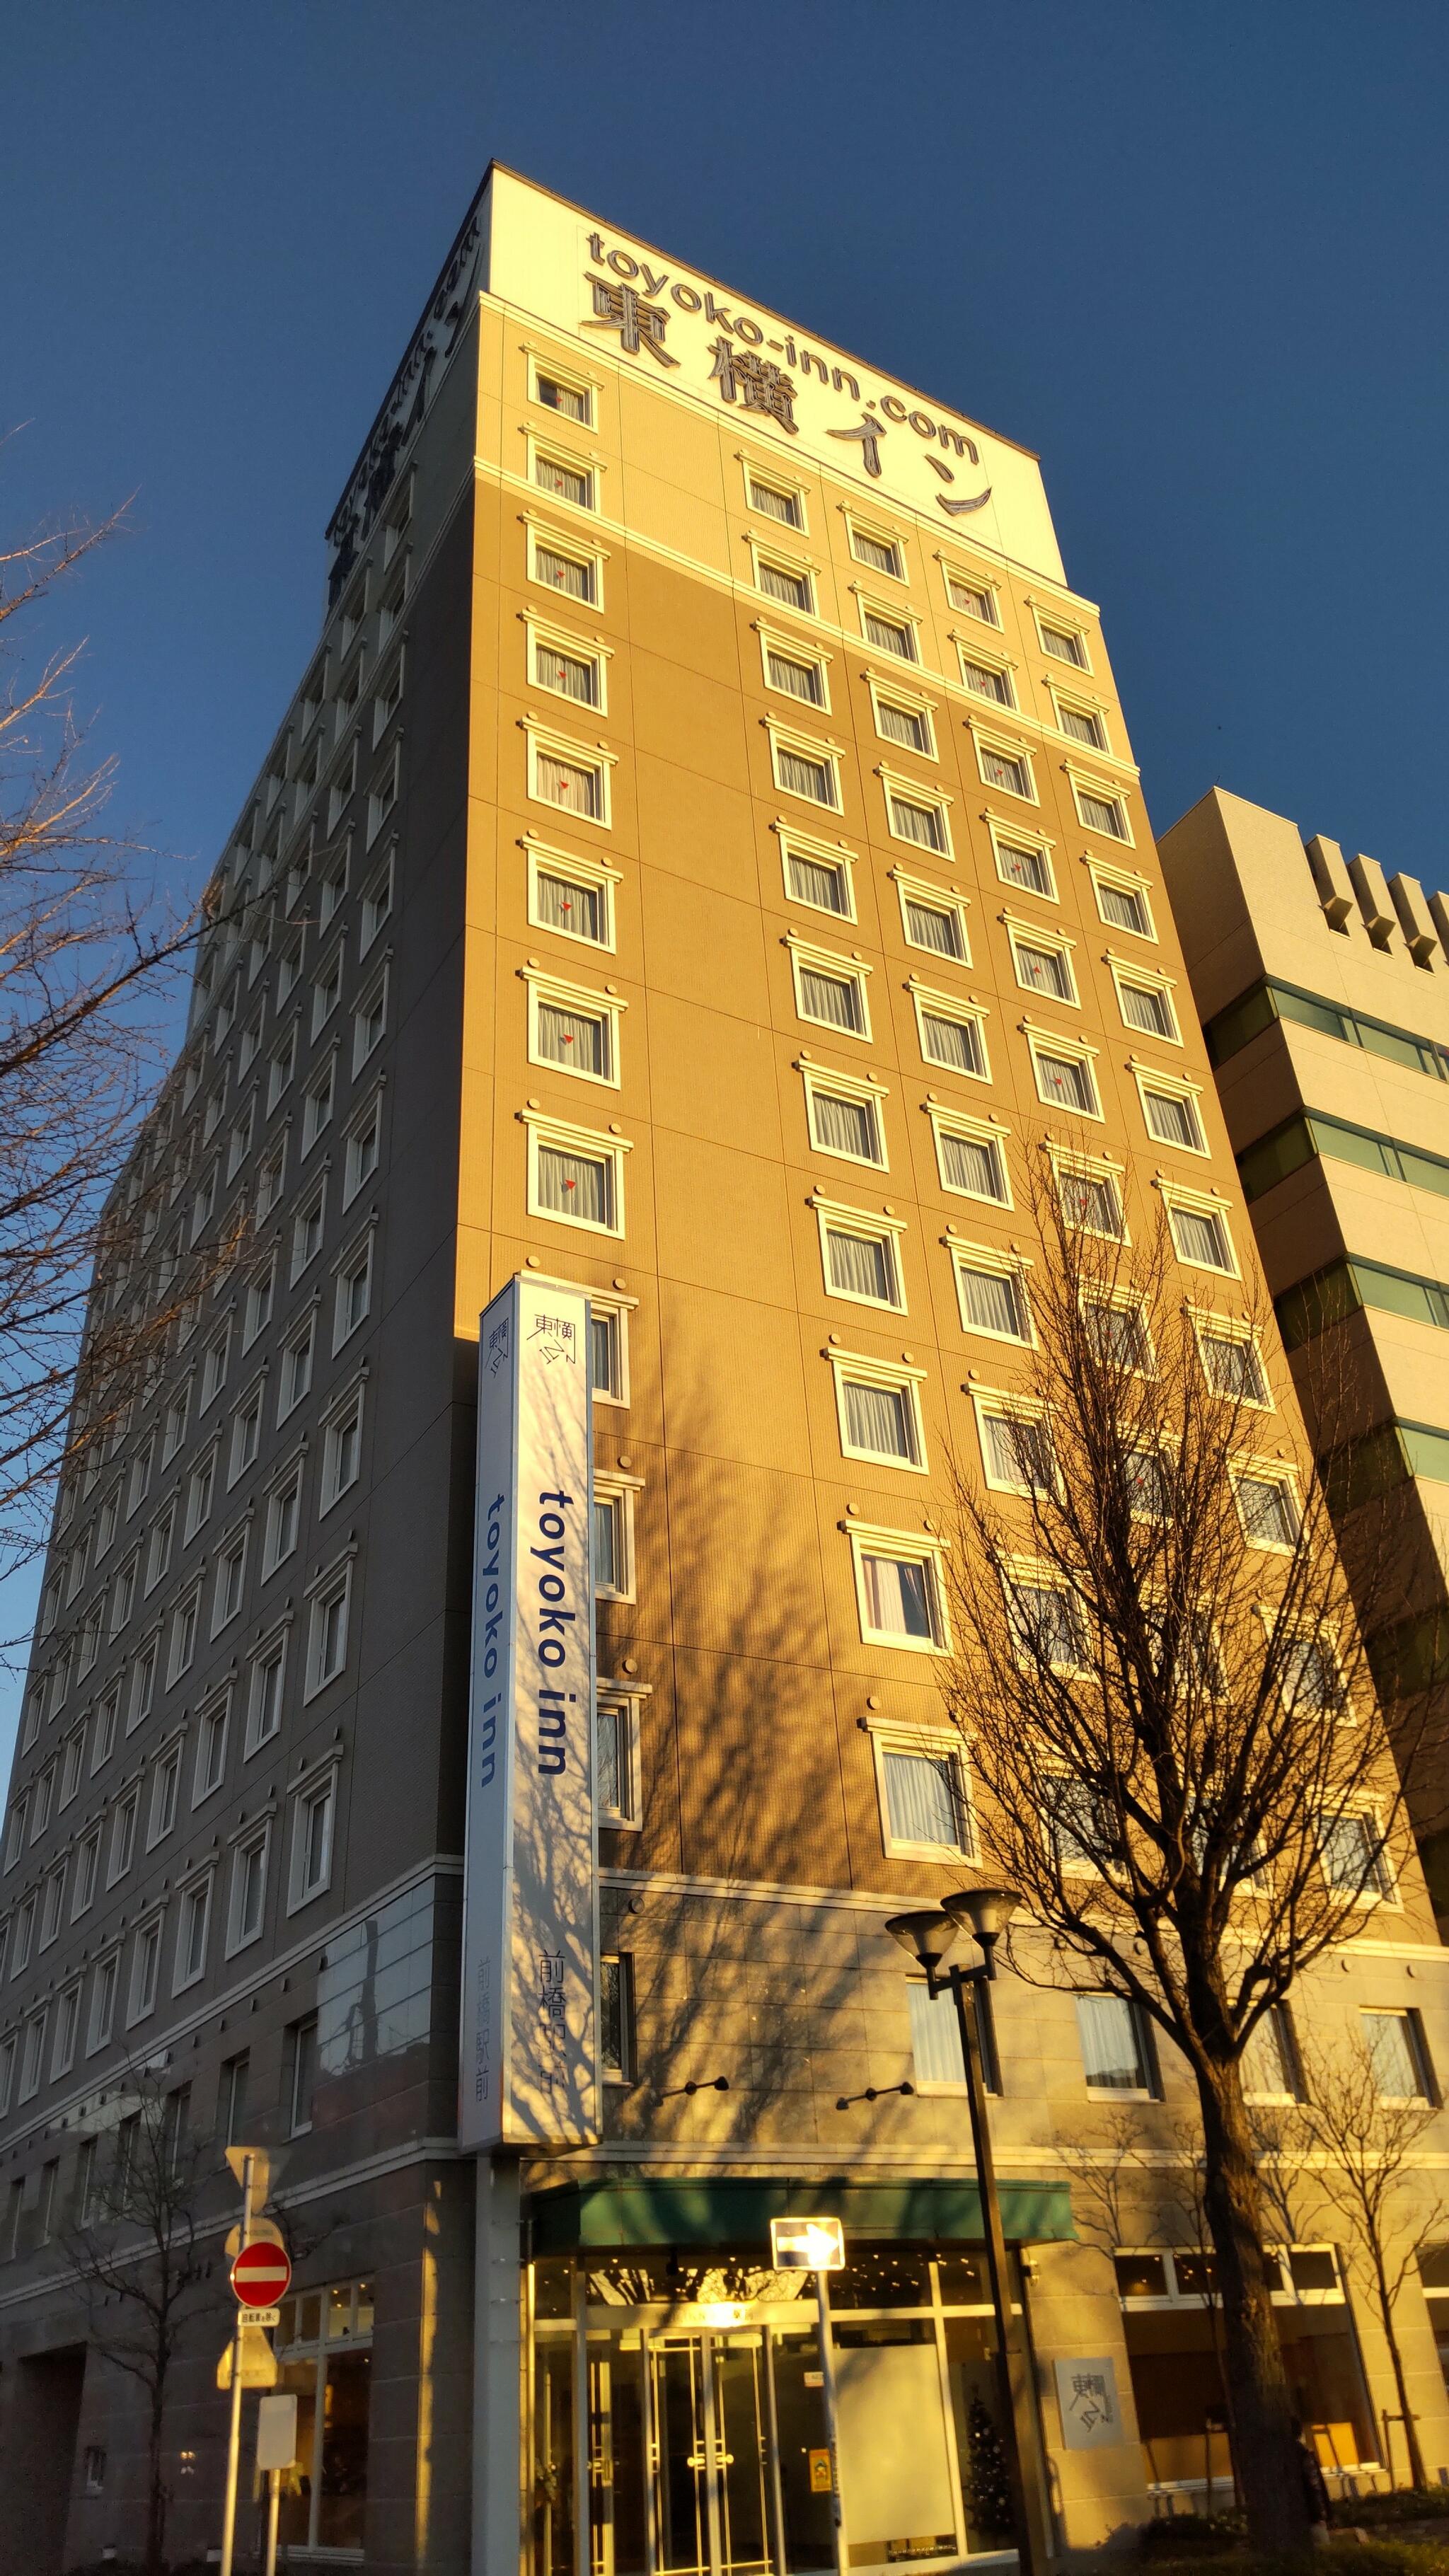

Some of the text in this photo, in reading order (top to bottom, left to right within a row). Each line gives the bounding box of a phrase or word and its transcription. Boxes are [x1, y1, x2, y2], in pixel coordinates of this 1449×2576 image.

[581, 270, 993, 516] 東横イン
[585, 231, 980, 466] toyoko-inn.com
[481, 1494, 505, 1788] toyoko inn
[530, 1489, 577, 1775] toyoko inn
